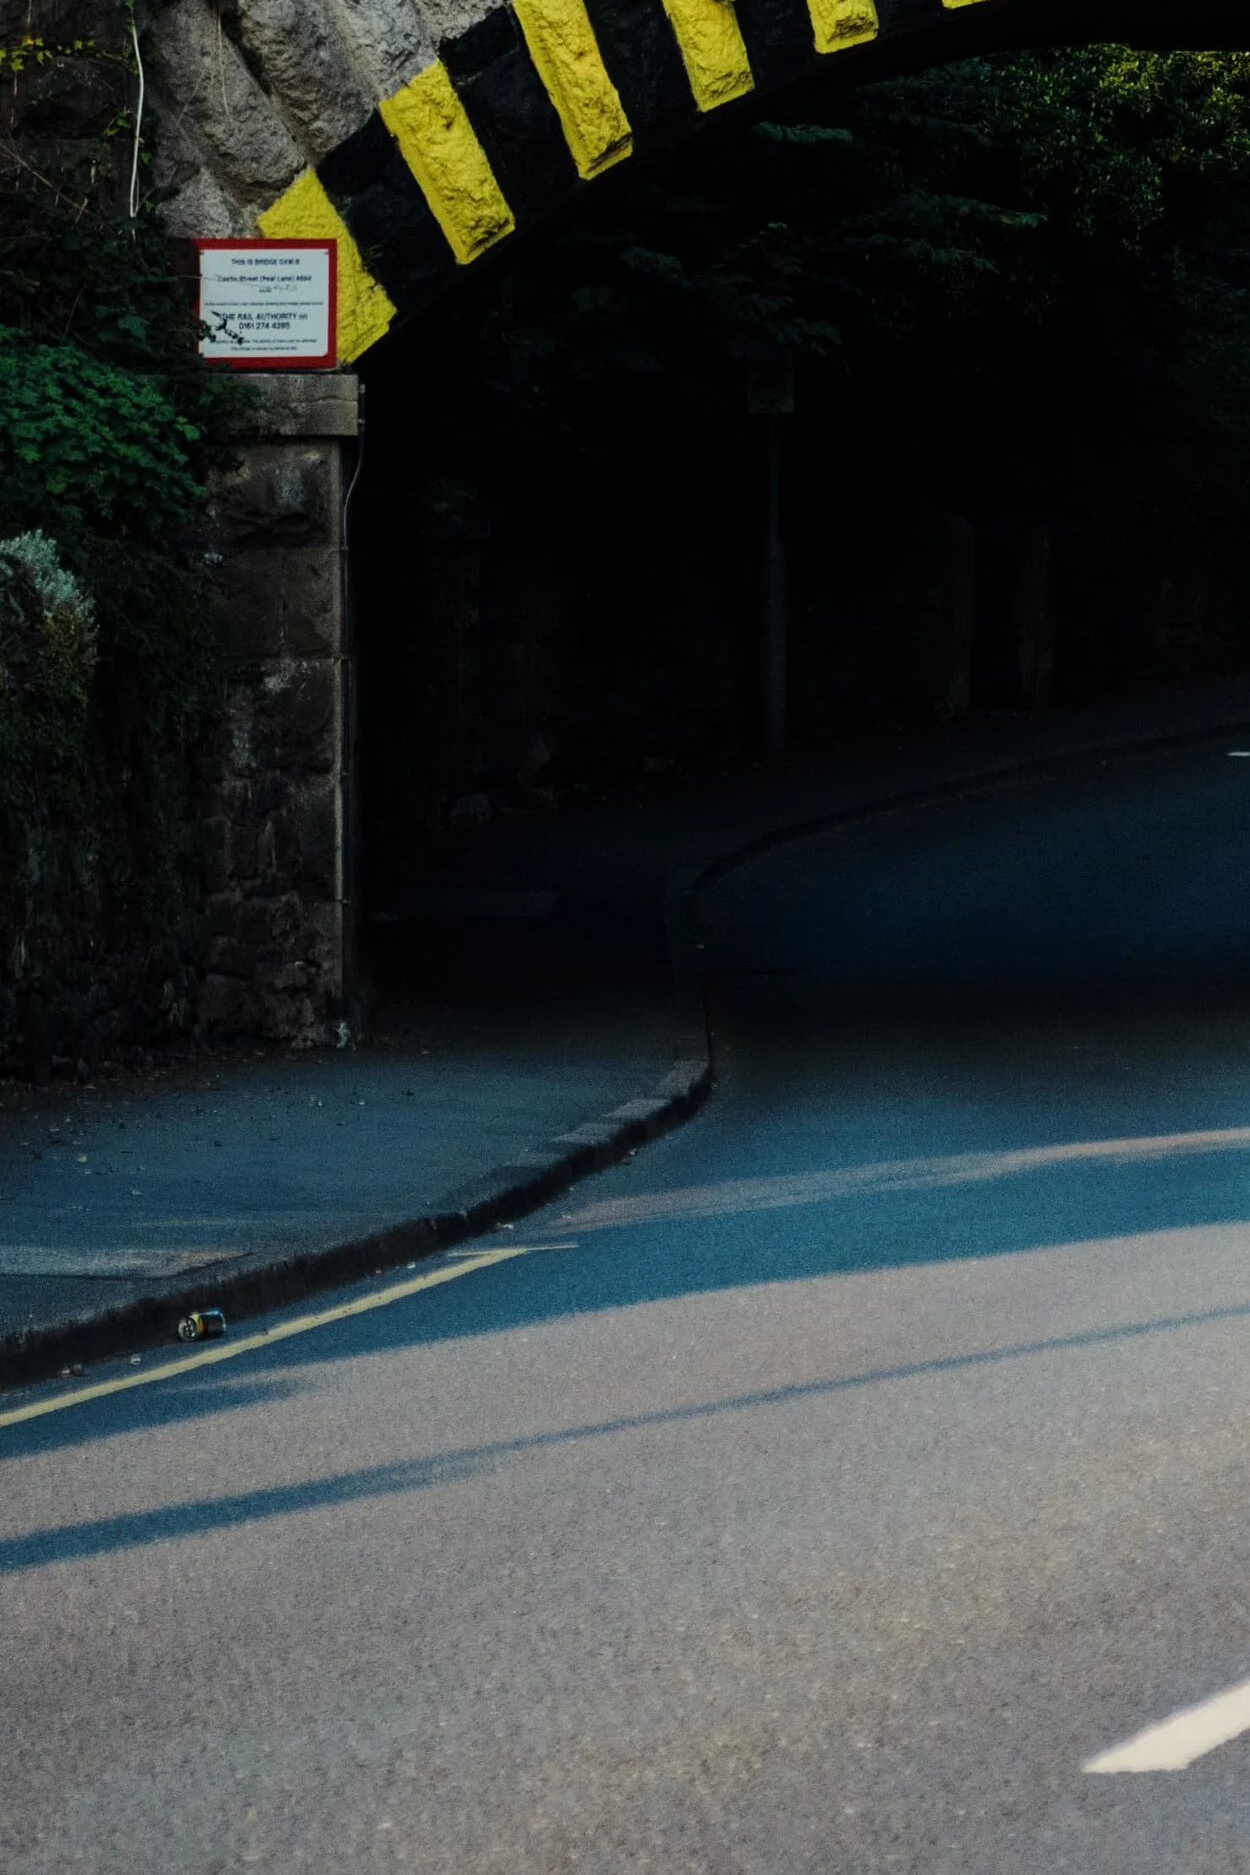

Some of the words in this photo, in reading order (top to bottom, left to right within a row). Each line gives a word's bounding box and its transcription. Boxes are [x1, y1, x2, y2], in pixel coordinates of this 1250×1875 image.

[247, 258, 253, 266] IS
[255, 258, 277, 266] BRIDGE
[255, 322, 269, 330] 274
